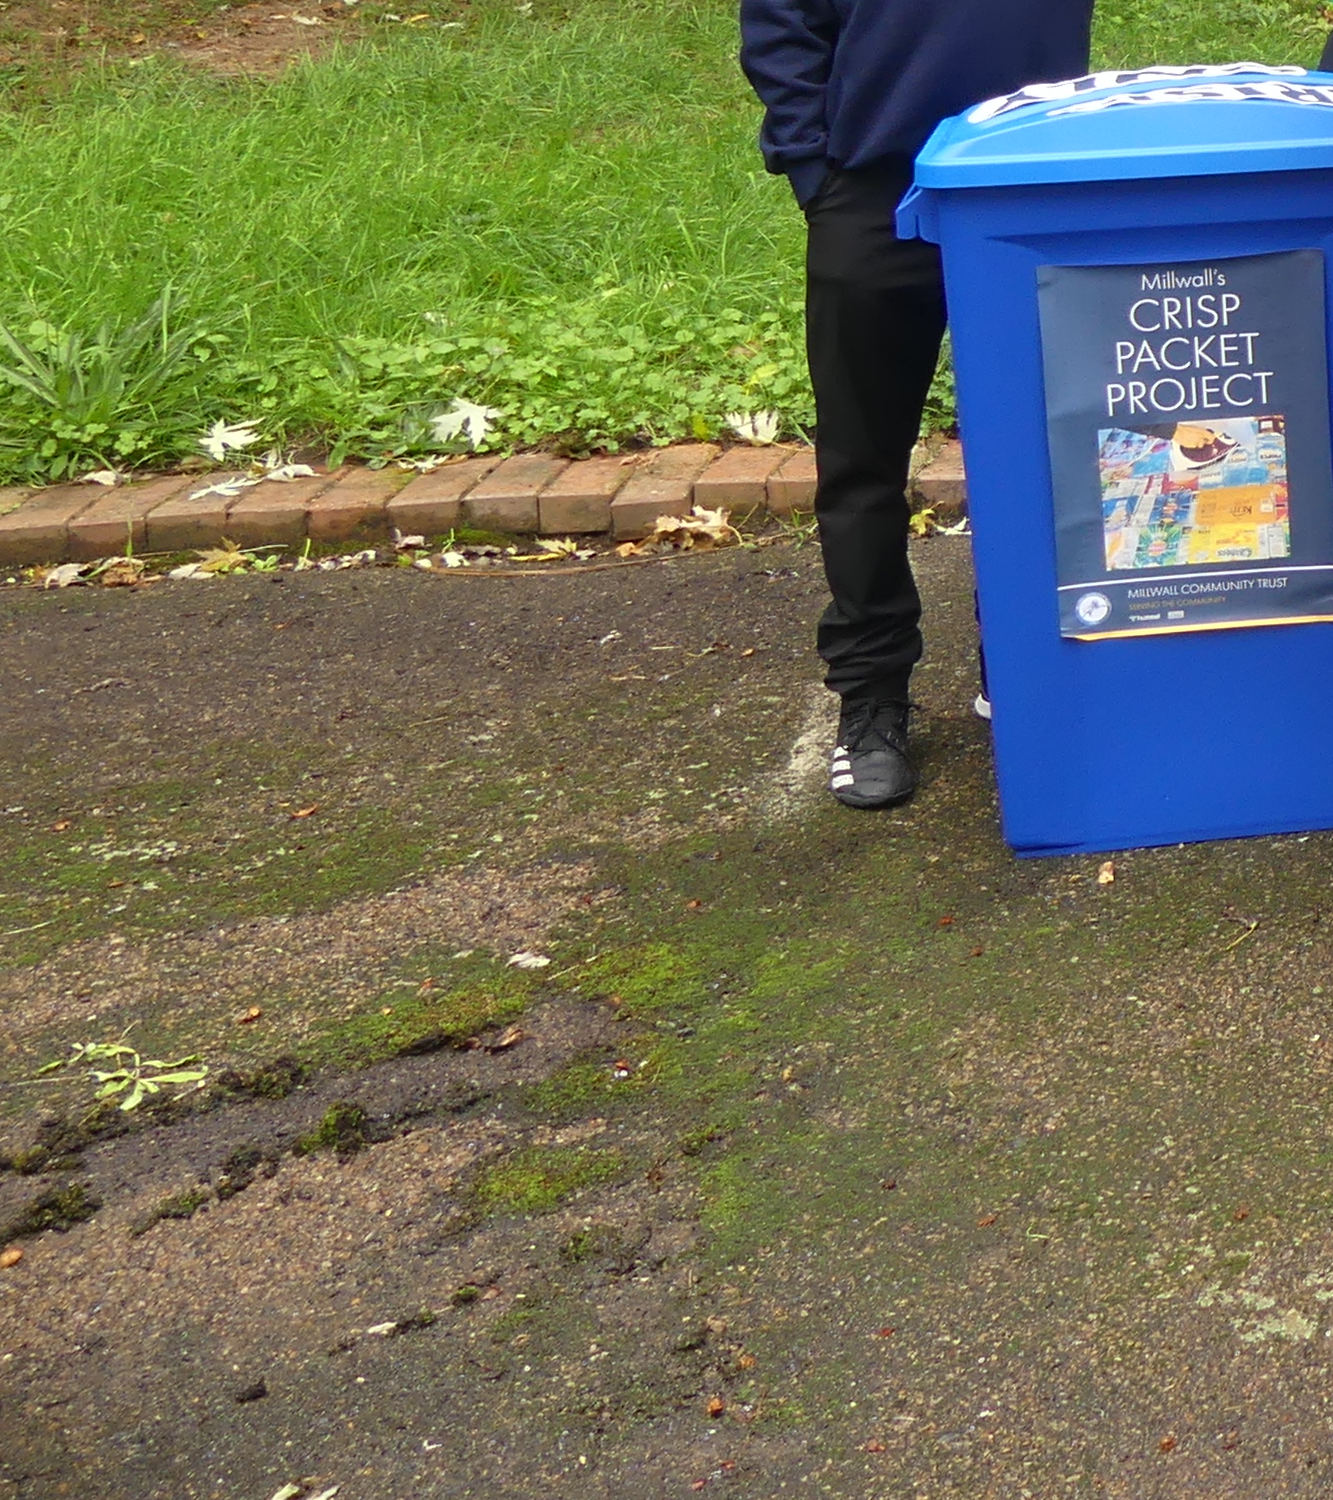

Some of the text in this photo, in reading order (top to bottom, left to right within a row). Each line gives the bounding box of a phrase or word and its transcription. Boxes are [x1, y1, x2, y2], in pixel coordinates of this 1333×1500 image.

[1140, 269, 1226, 291] Millwall's
[1130, 293, 1241, 332] CRISP
[1115, 332, 1260, 374] PACKET
[1106, 371, 1274, 417] PROJECT
[1127, 577, 1288, 599] MILLWALL COMMUNITY TRUST
